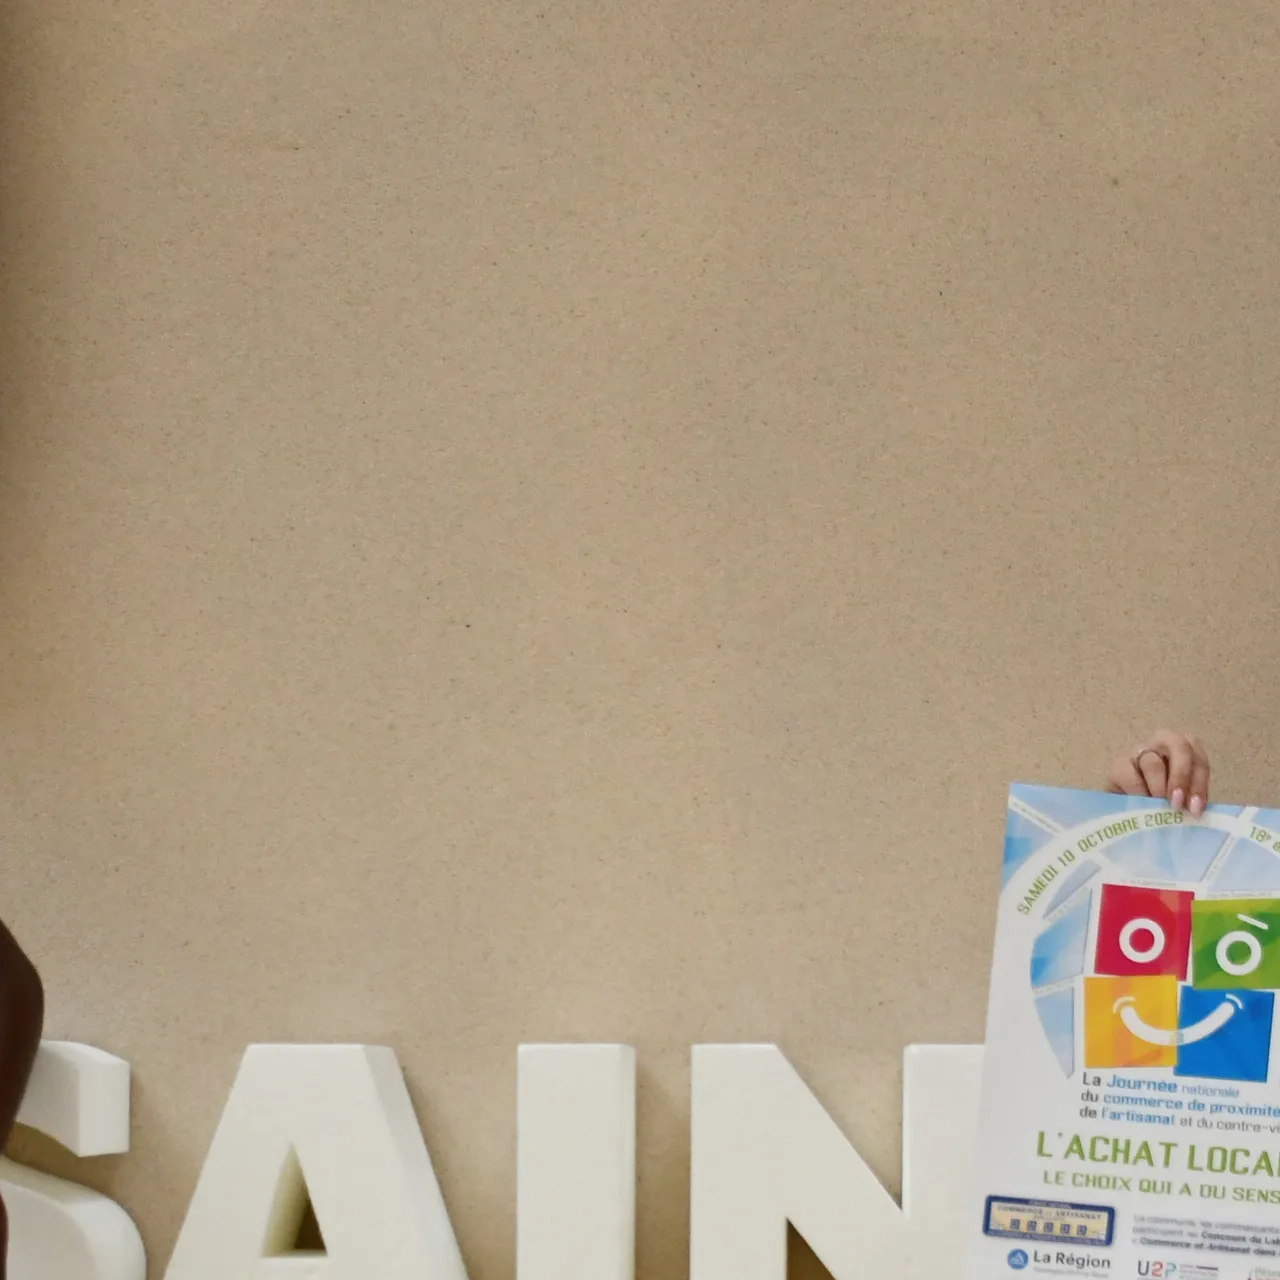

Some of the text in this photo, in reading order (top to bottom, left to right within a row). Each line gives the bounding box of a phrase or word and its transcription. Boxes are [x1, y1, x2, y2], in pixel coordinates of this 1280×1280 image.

[1017, 863, 1059, 915] SAMEDI
[1057, 849, 1076, 867] 10
[1078, 814, 1141, 854] OCTOBRE
[1144, 810, 1185, 828] 2026
[1081, 1071, 1102, 1087] La
[1081, 1089, 1100, 1103] du
[1103, 1093, 1184, 1111] commerce
[1187, 1098, 1207, 1112] de
[1079, 1105, 1098, 1120] de
[1179, 1115, 1194, 1128] et
[1196, 1116, 1215, 1130] du
[1037, 1131, 1178, 1169] L'ACHAT
[1043, 1170, 1066, 1187] LE
[1071, 1172, 1132, 1193] CHOIX
[1138, 1178, 1173, 1196] QUI
[1178, 1183, 1194, 1198] A
[1199, 1184, 1227, 1200] DU
[1032, 1249, 1112, 1270] La Région
